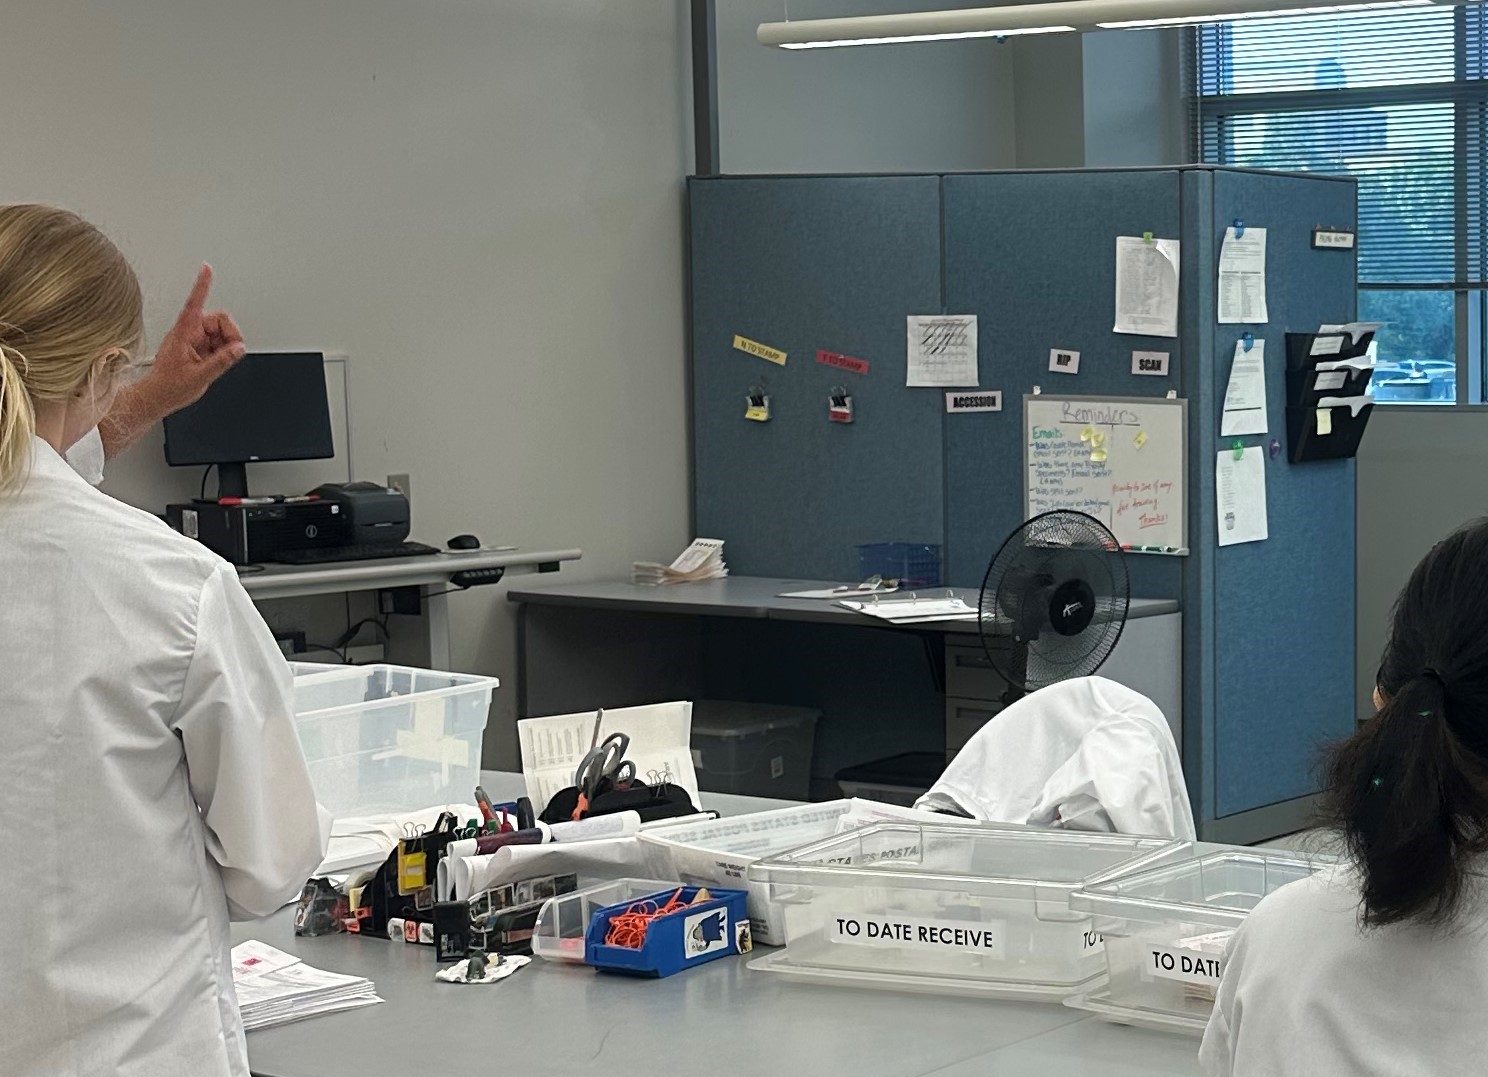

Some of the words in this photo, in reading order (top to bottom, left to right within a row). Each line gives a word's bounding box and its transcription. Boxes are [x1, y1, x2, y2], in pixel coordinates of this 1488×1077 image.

[756, 345, 780, 361] STAMP
[1056, 354, 1071, 366] RIP
[1138, 359, 1162, 372] SCAN
[953, 395, 997, 409] ACCESSION
[1062, 402, 1138, 422] Reminders
[836, 918, 861, 936] TO
[867, 922, 912, 941] DATE
[918, 926, 993, 948] RECEIVE
[1083, 930, 1097, 950] TO
[1152, 951, 1175, 970] TO
